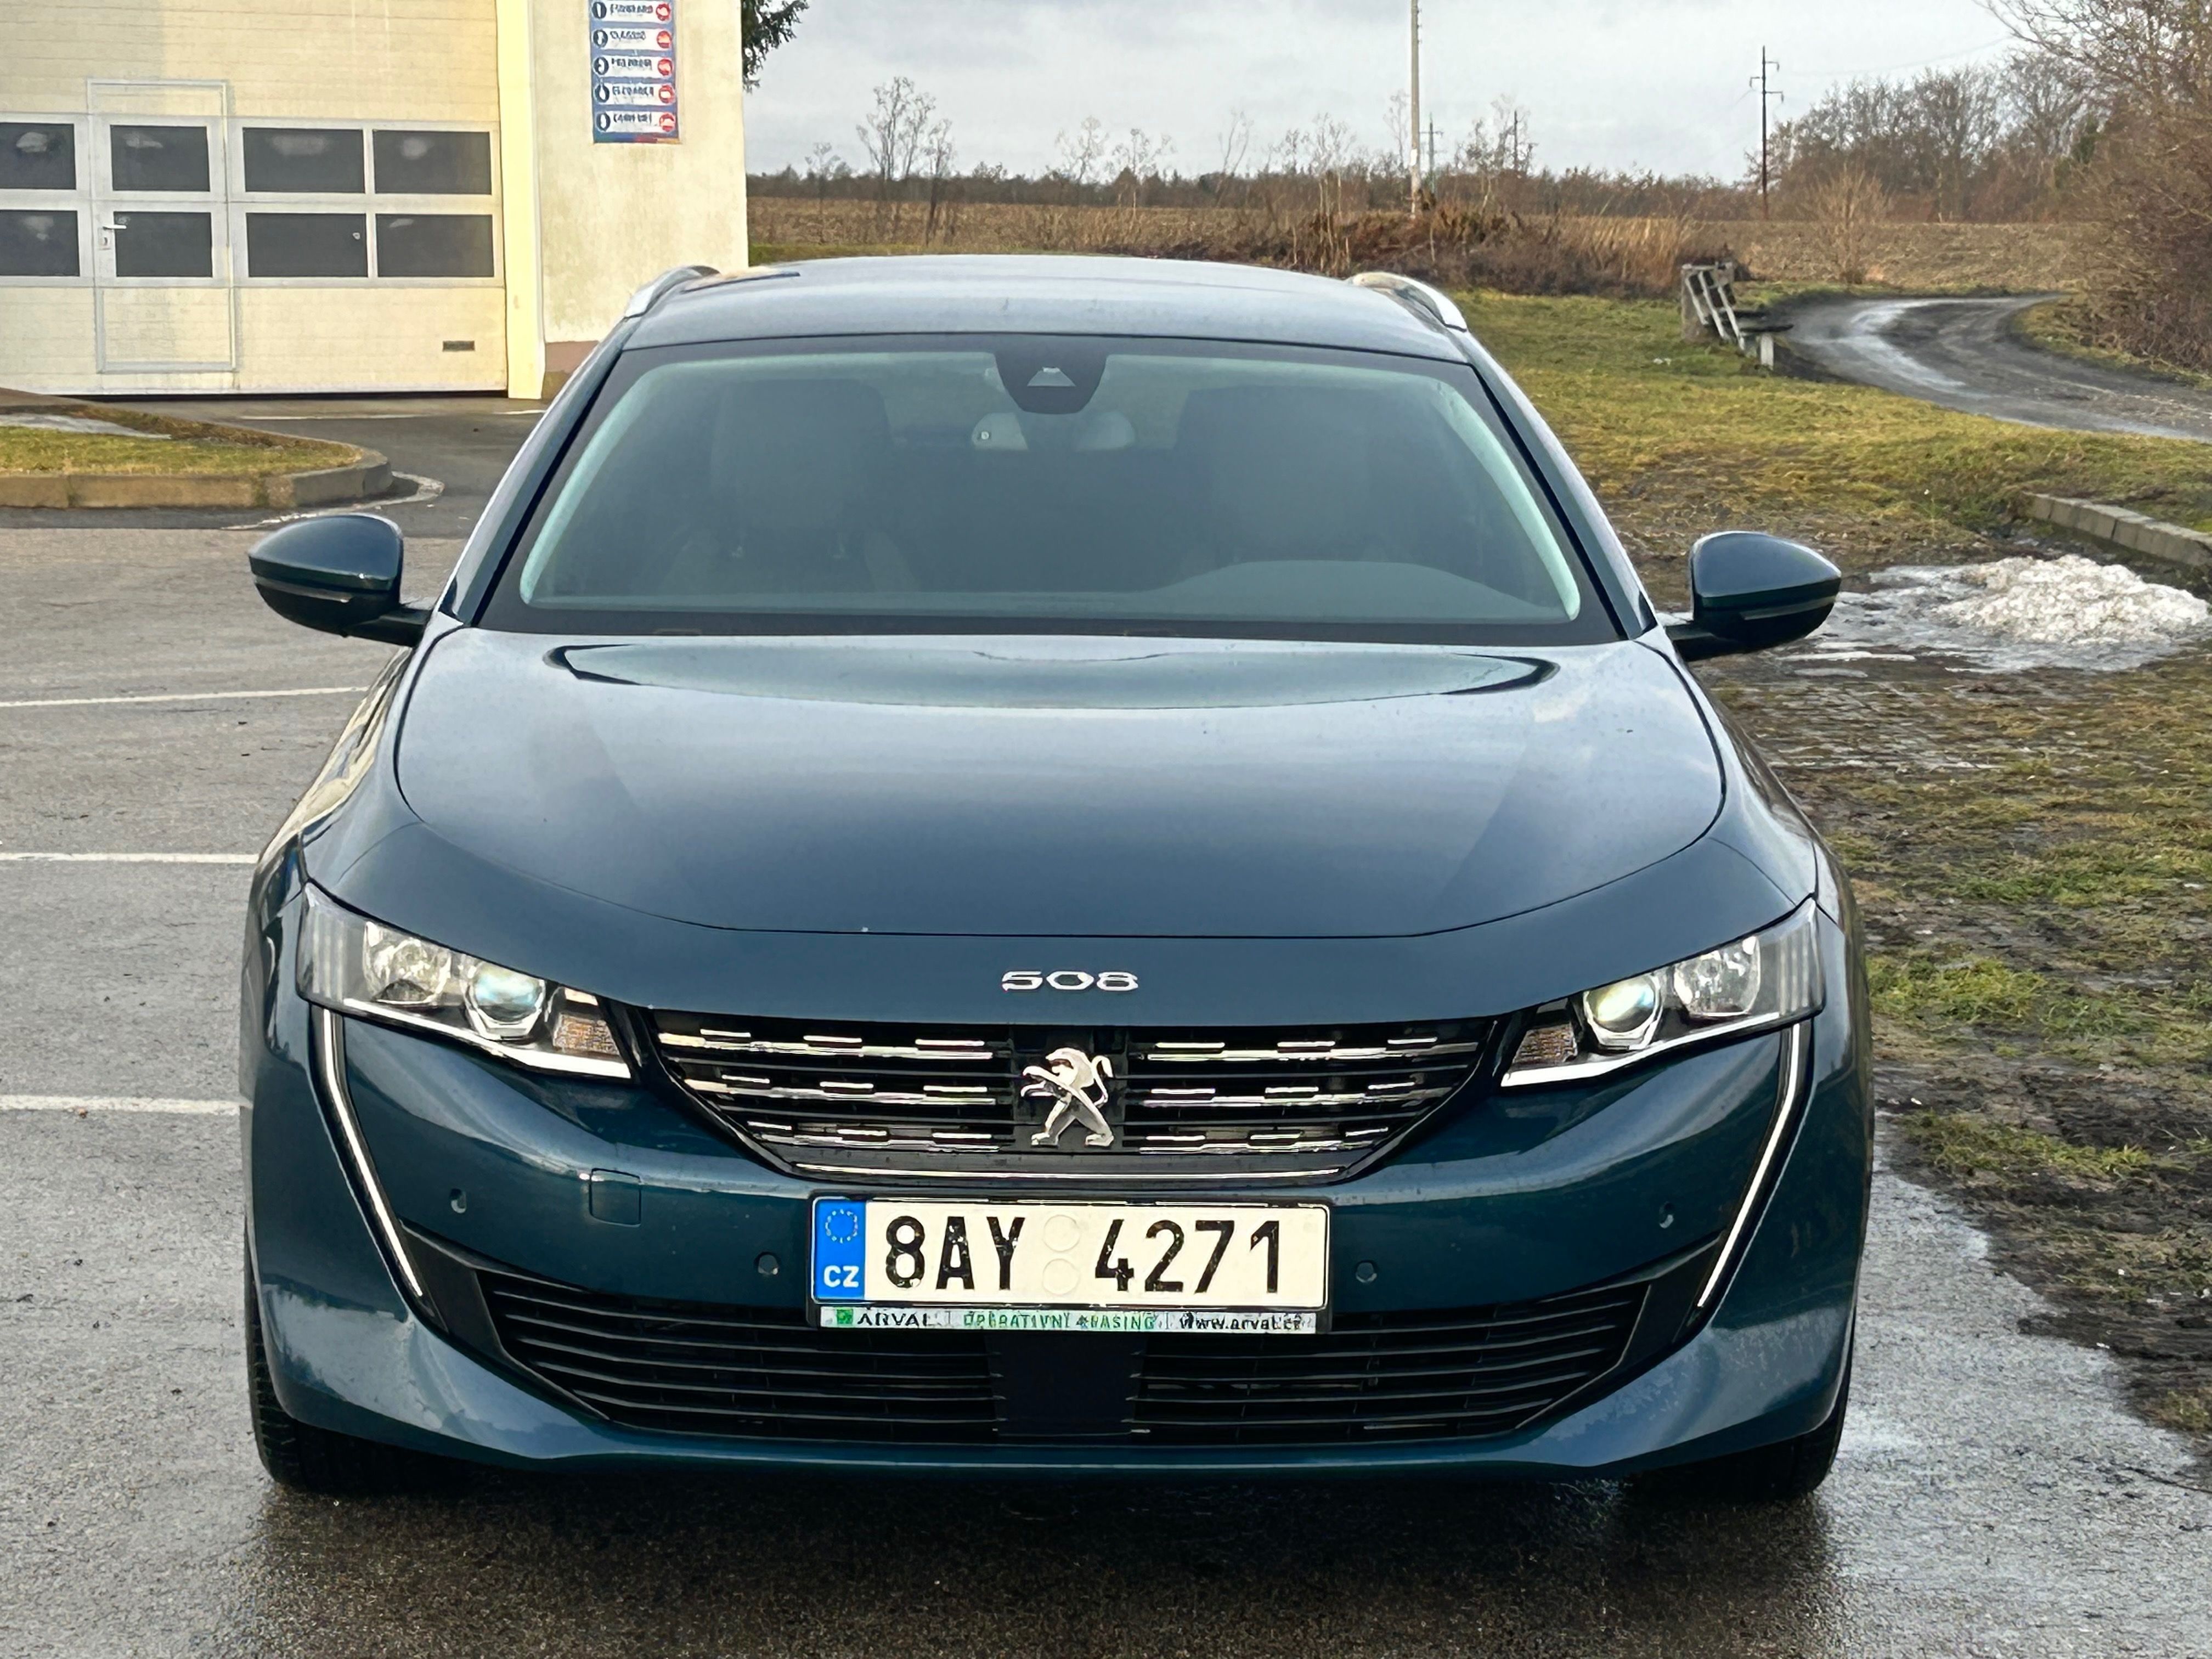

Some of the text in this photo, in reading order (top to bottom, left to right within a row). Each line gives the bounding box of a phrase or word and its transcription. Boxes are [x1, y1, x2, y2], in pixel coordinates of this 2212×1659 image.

[1001, 970, 1139, 992] 508
[884, 1215, 1279, 1295] 8AY 4271
[823, 1265, 860, 1288] CZ
